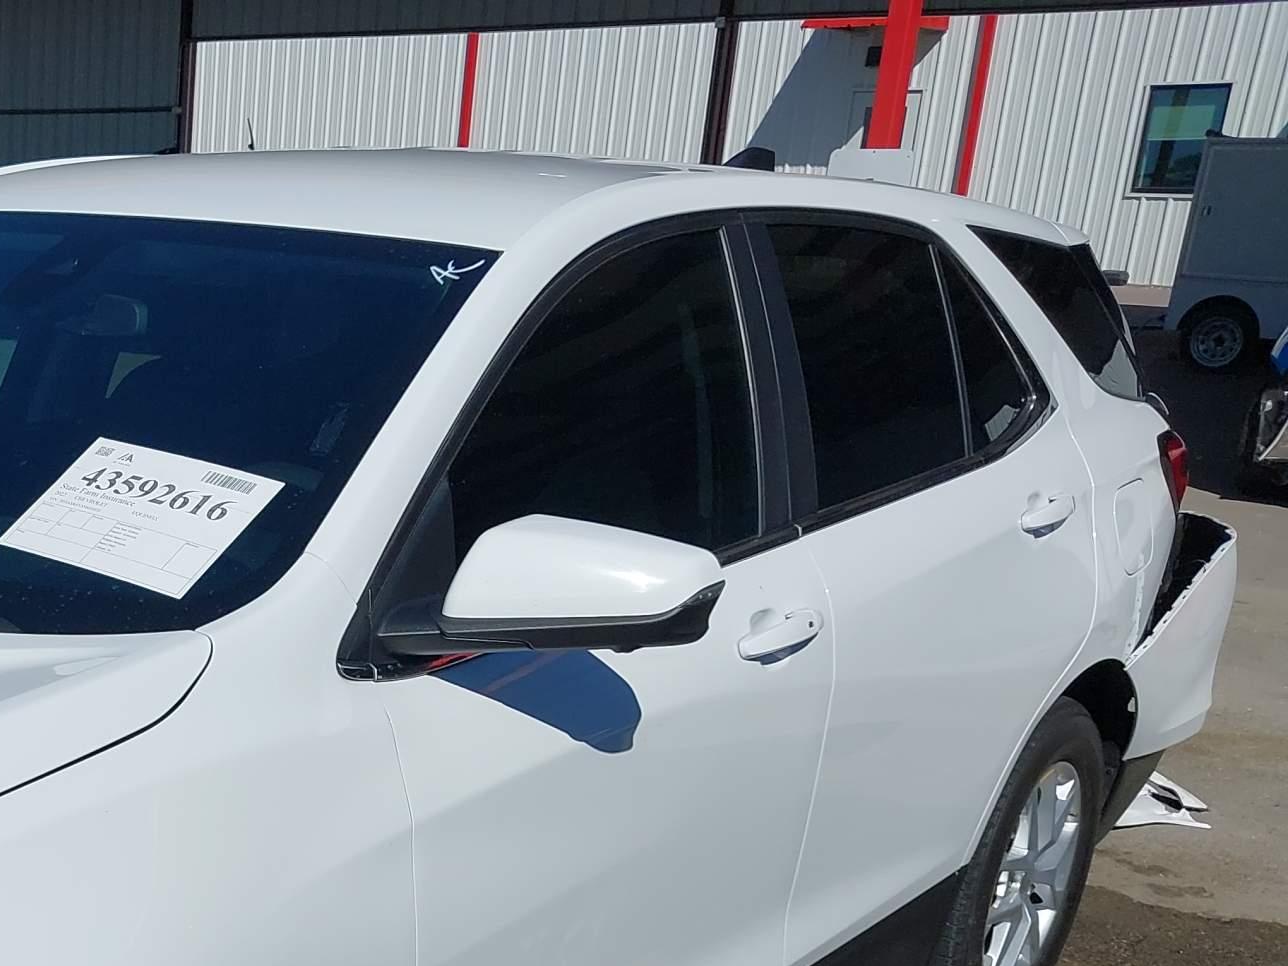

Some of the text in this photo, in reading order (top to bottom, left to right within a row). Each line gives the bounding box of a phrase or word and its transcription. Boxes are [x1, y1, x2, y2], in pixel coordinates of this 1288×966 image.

[59, 482, 80, 495] State
[80, 486, 100, 500] Farm
[99, 490, 136, 508] Insurance
[81, 466, 239, 522] 43592616
